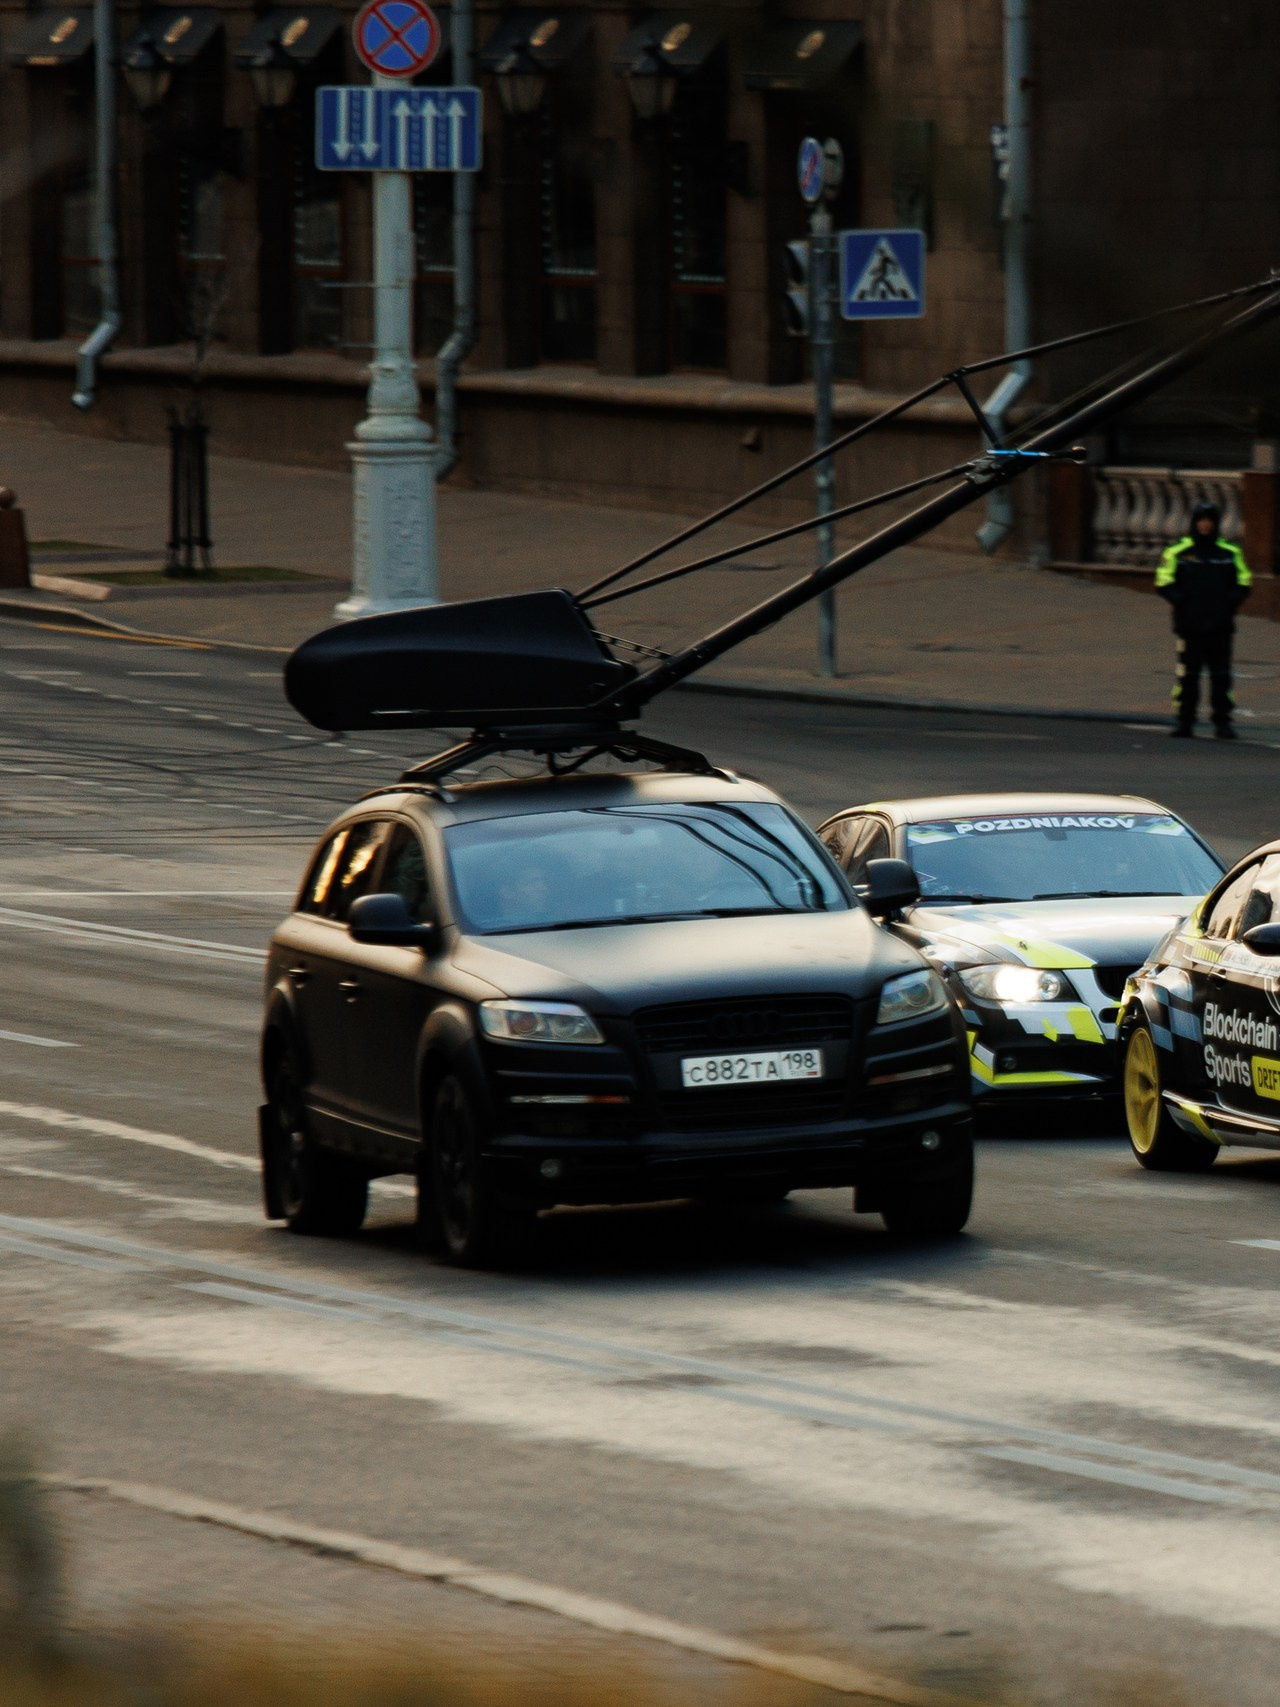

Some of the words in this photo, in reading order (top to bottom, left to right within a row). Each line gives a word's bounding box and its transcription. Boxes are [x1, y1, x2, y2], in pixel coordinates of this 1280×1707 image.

[954, 816, 1136, 835] POZDNIAKOV
[1203, 1002, 1277, 1051] Blockchain
[782, 1052, 816, 1070] 198
[1204, 1044, 1252, 1087] Sports
